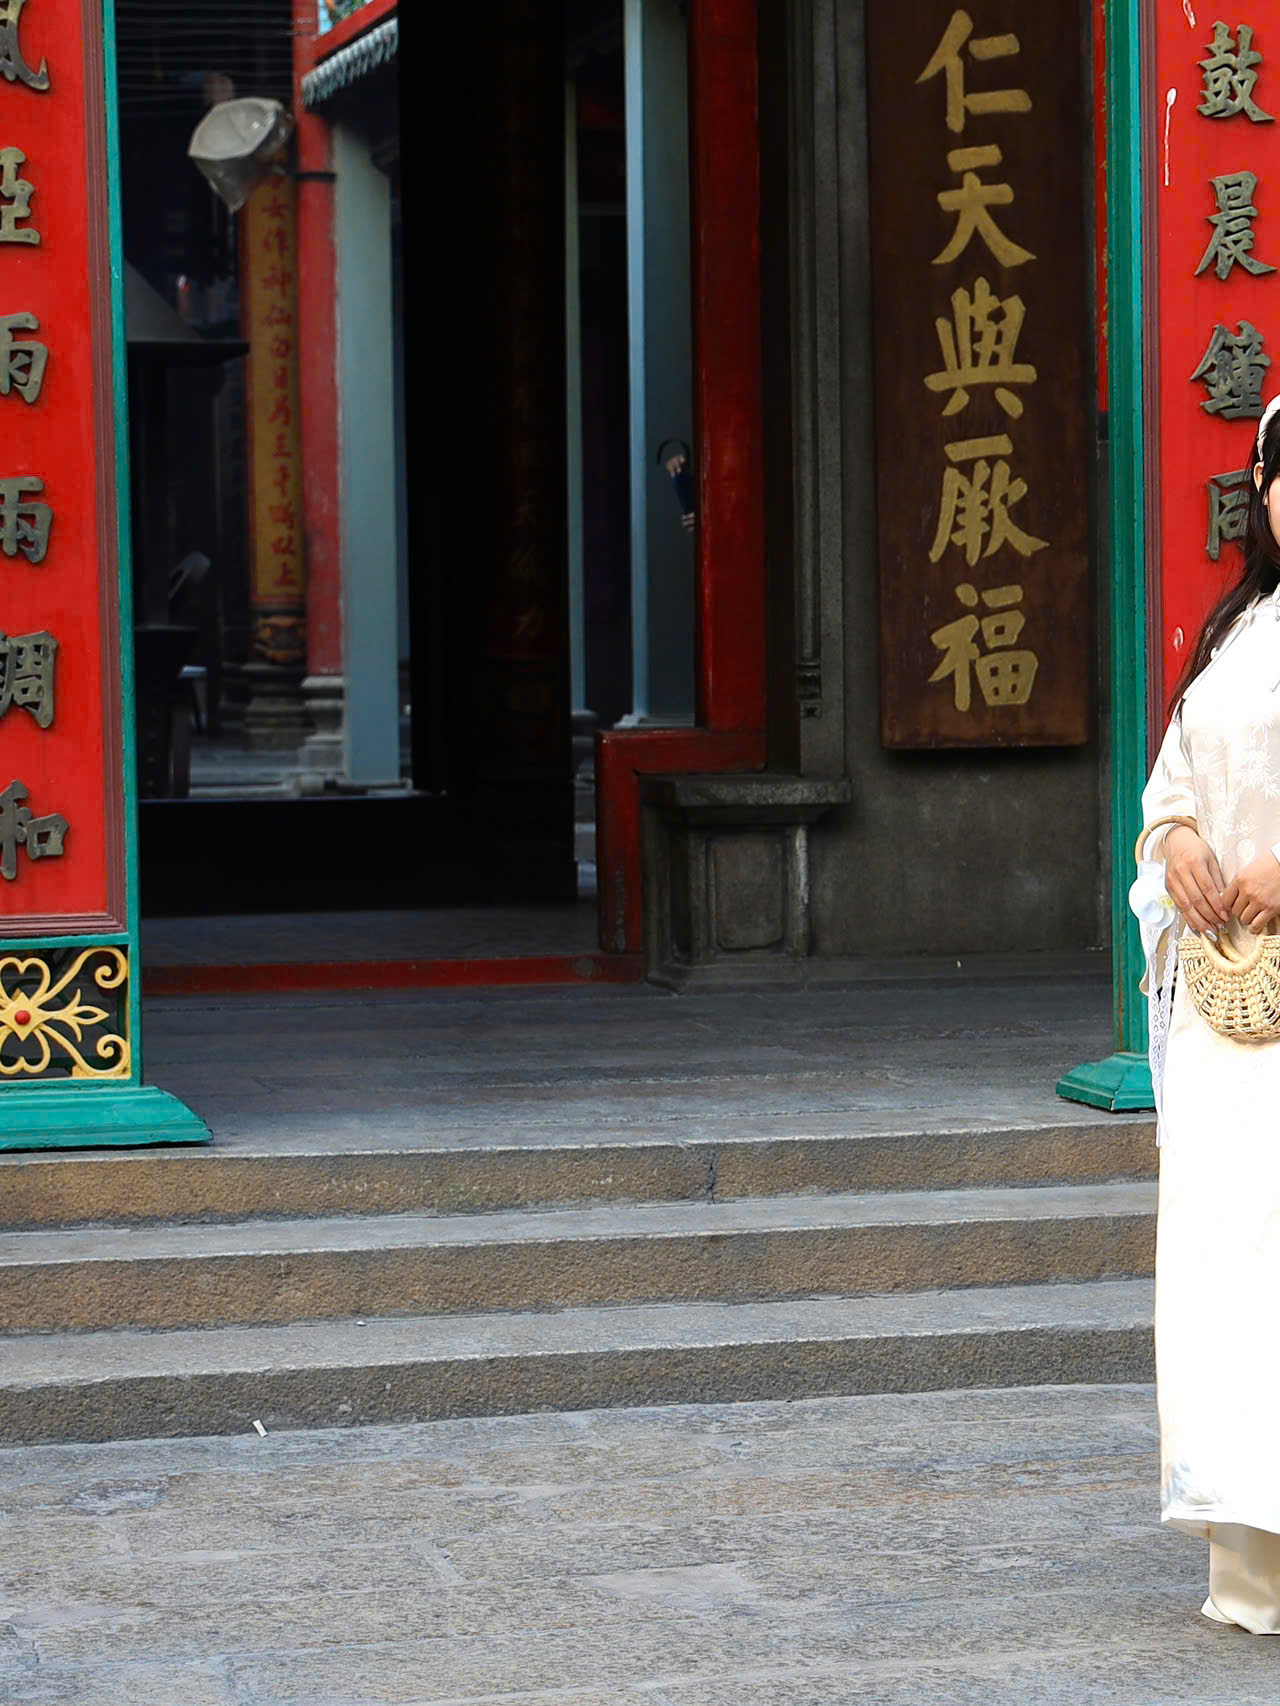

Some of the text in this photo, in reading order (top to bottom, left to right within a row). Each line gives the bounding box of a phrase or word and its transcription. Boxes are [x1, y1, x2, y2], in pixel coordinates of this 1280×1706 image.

[916, 9, 1050, 712] 仁天與厥福
